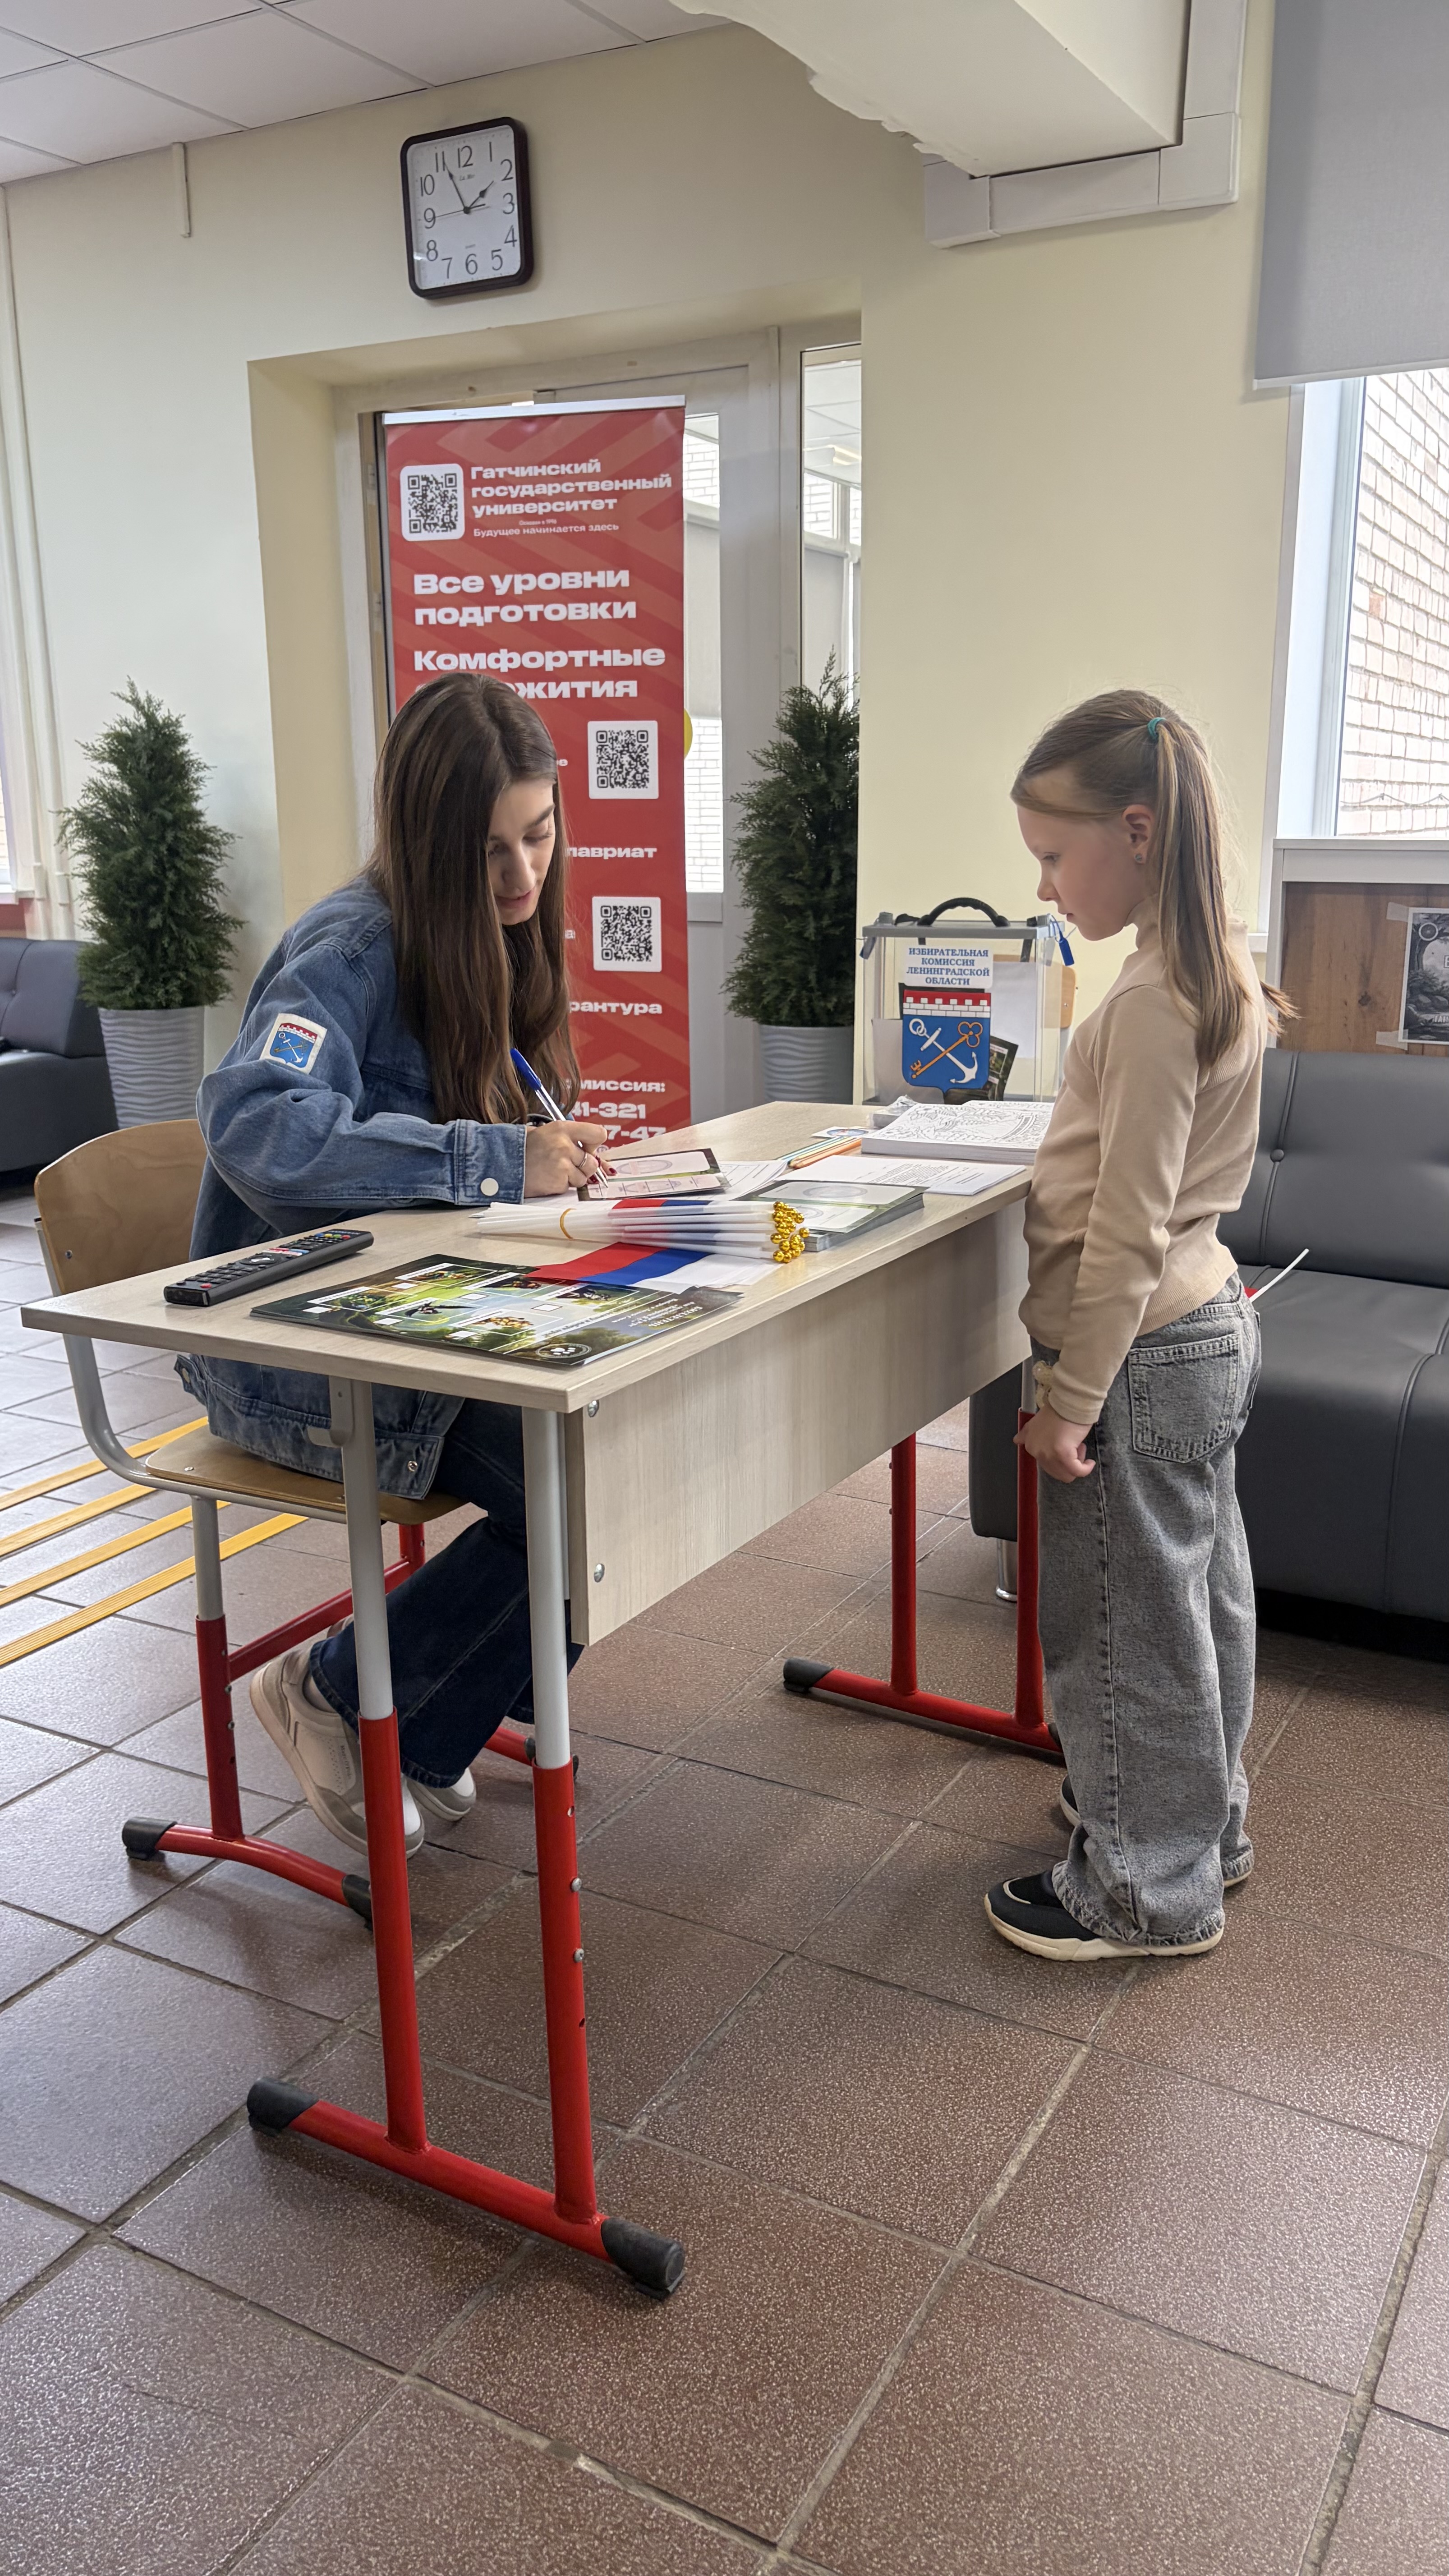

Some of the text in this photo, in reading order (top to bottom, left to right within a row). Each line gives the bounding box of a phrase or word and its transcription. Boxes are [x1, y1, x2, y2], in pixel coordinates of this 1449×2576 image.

[435, 151, 446, 173] 11
[457, 145, 474, 168] 12
[489, 141, 492, 162] 1
[501, 159, 514, 181] 2
[420, 175, 435, 196] 10
[503, 193, 515, 215] 3
[423, 208, 436, 229] 9
[504, 225, 517, 247] 4
[426, 240, 438, 262] 8
[491, 249, 503, 271] 5
[442, 257, 452, 279] 7
[465, 253, 478, 275] 6
[471, 459, 601, 479] Гатчинский
[471, 474, 672, 498] государственный
[472, 497, 617, 518] университет
[474, 528, 520, 538] Будущее
[523, 524, 585, 534] начинается
[414, 570, 630, 595] Все уровни
[415, 601, 636, 627] подготовки
[414, 648, 666, 672] Комфортные
[509, 681, 638, 699] жития
[564, 847, 657, 860] лавриат
[909, 948, 989, 957] ИЗБИРАТЕЛЬНАЯ
[906, 966, 990, 976] ЛЕНИНГРАДСКОЙ
[925, 977, 970, 985] ОБЛАСТИ
[569, 1001, 662, 1015] рантура
[580, 1079, 666, 1092] миссия:
[603, 1125, 666, 1140] 7-47
